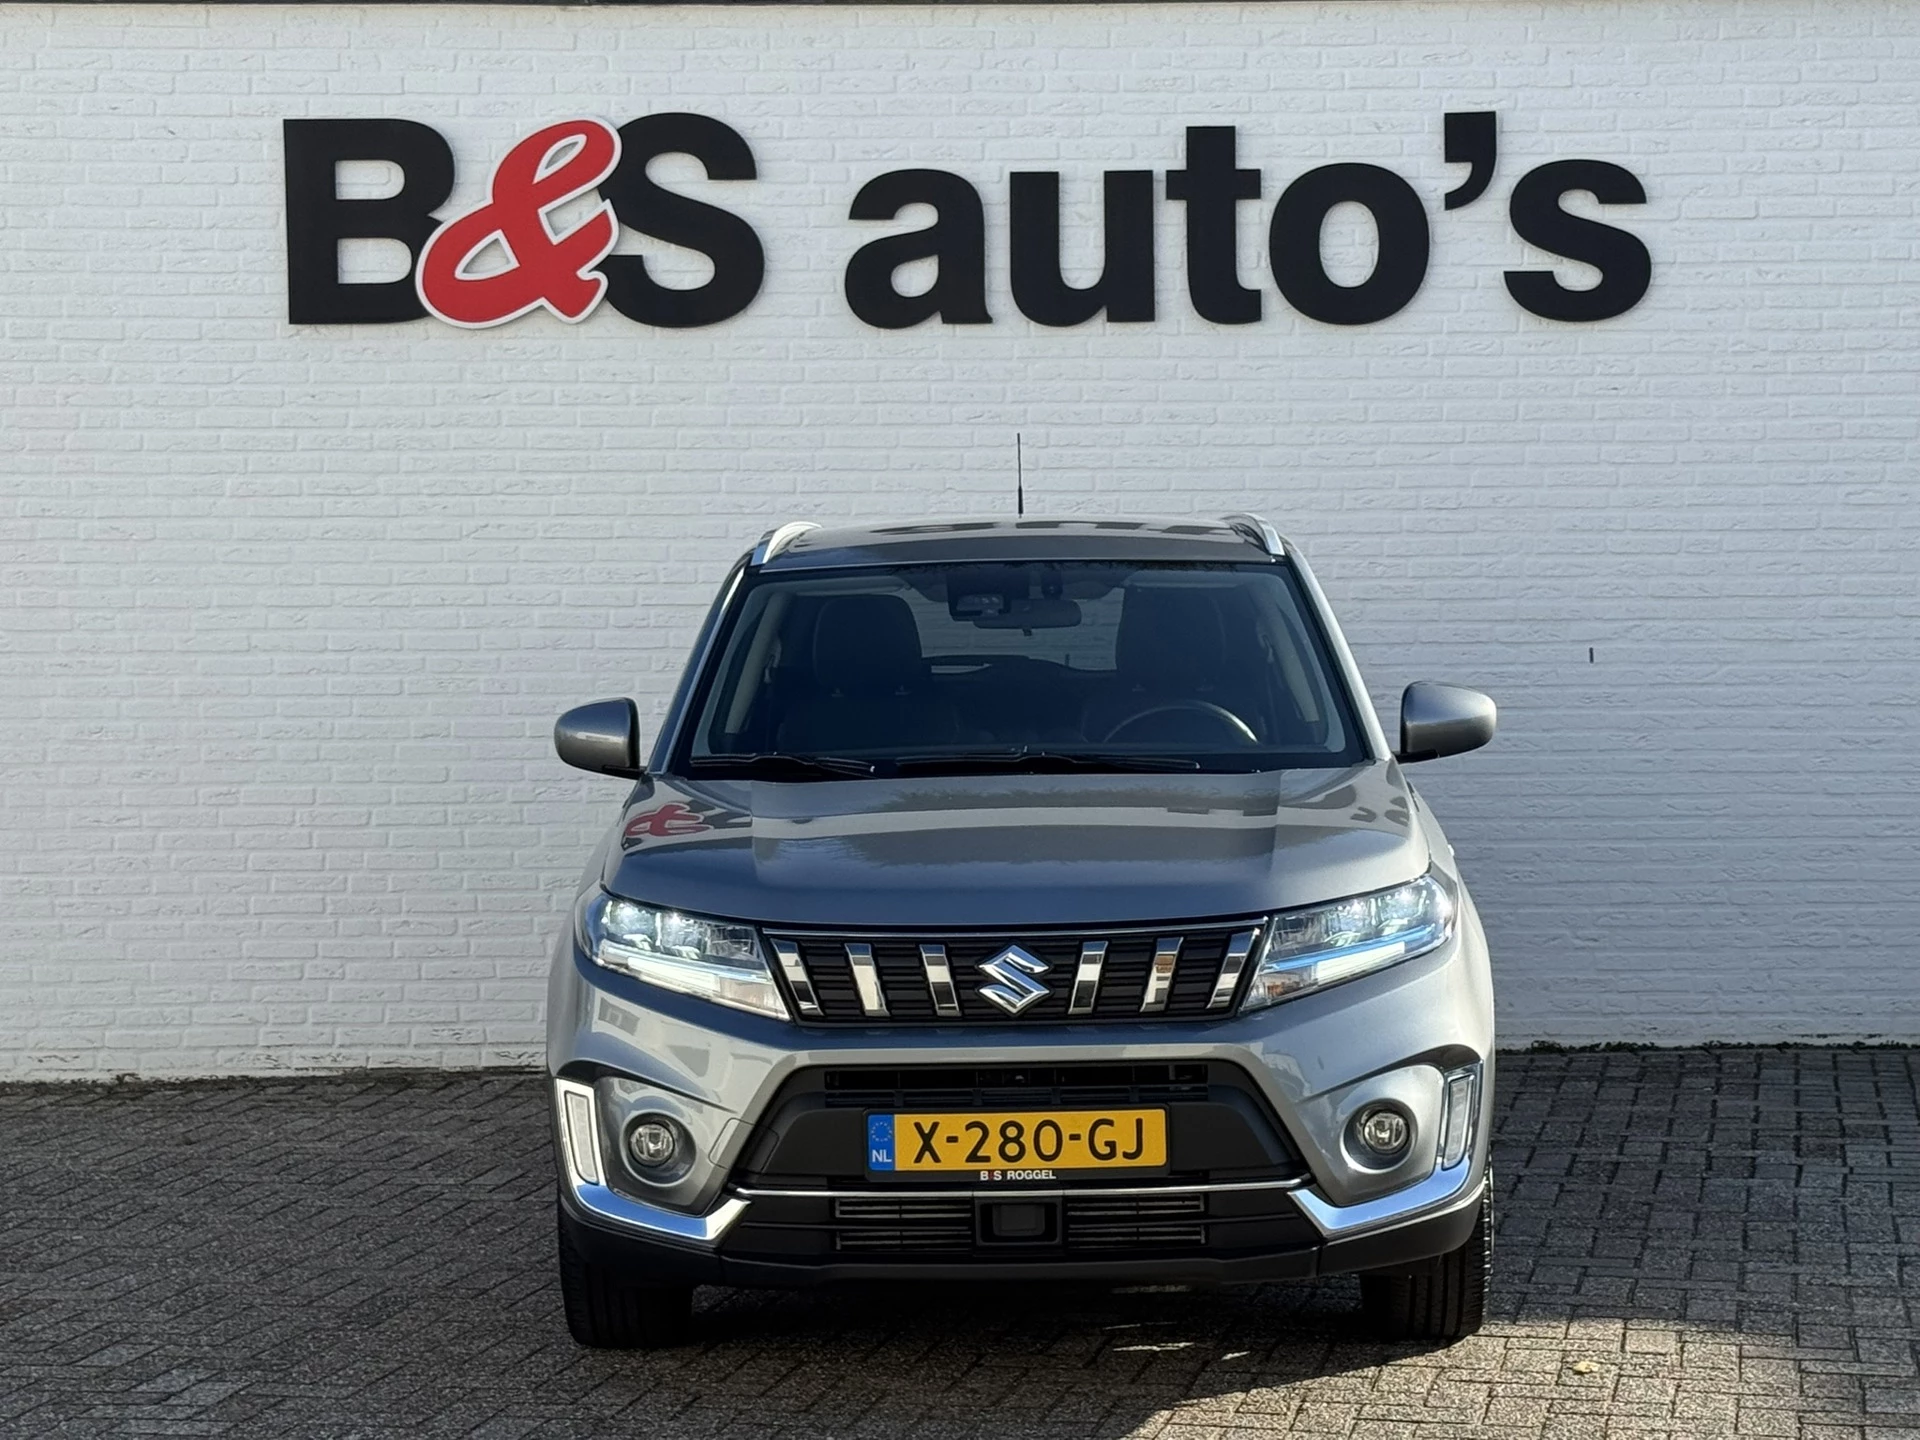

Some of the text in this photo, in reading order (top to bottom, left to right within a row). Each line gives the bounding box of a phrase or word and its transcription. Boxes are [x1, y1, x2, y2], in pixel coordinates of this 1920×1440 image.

[284, 111, 1652, 329] B&S auto's
[913, 1117, 1144, 1164] X-280-GJ
[871, 1149, 892, 1163] NL
[1007, 1169, 1057, 1180] ROGGEL
